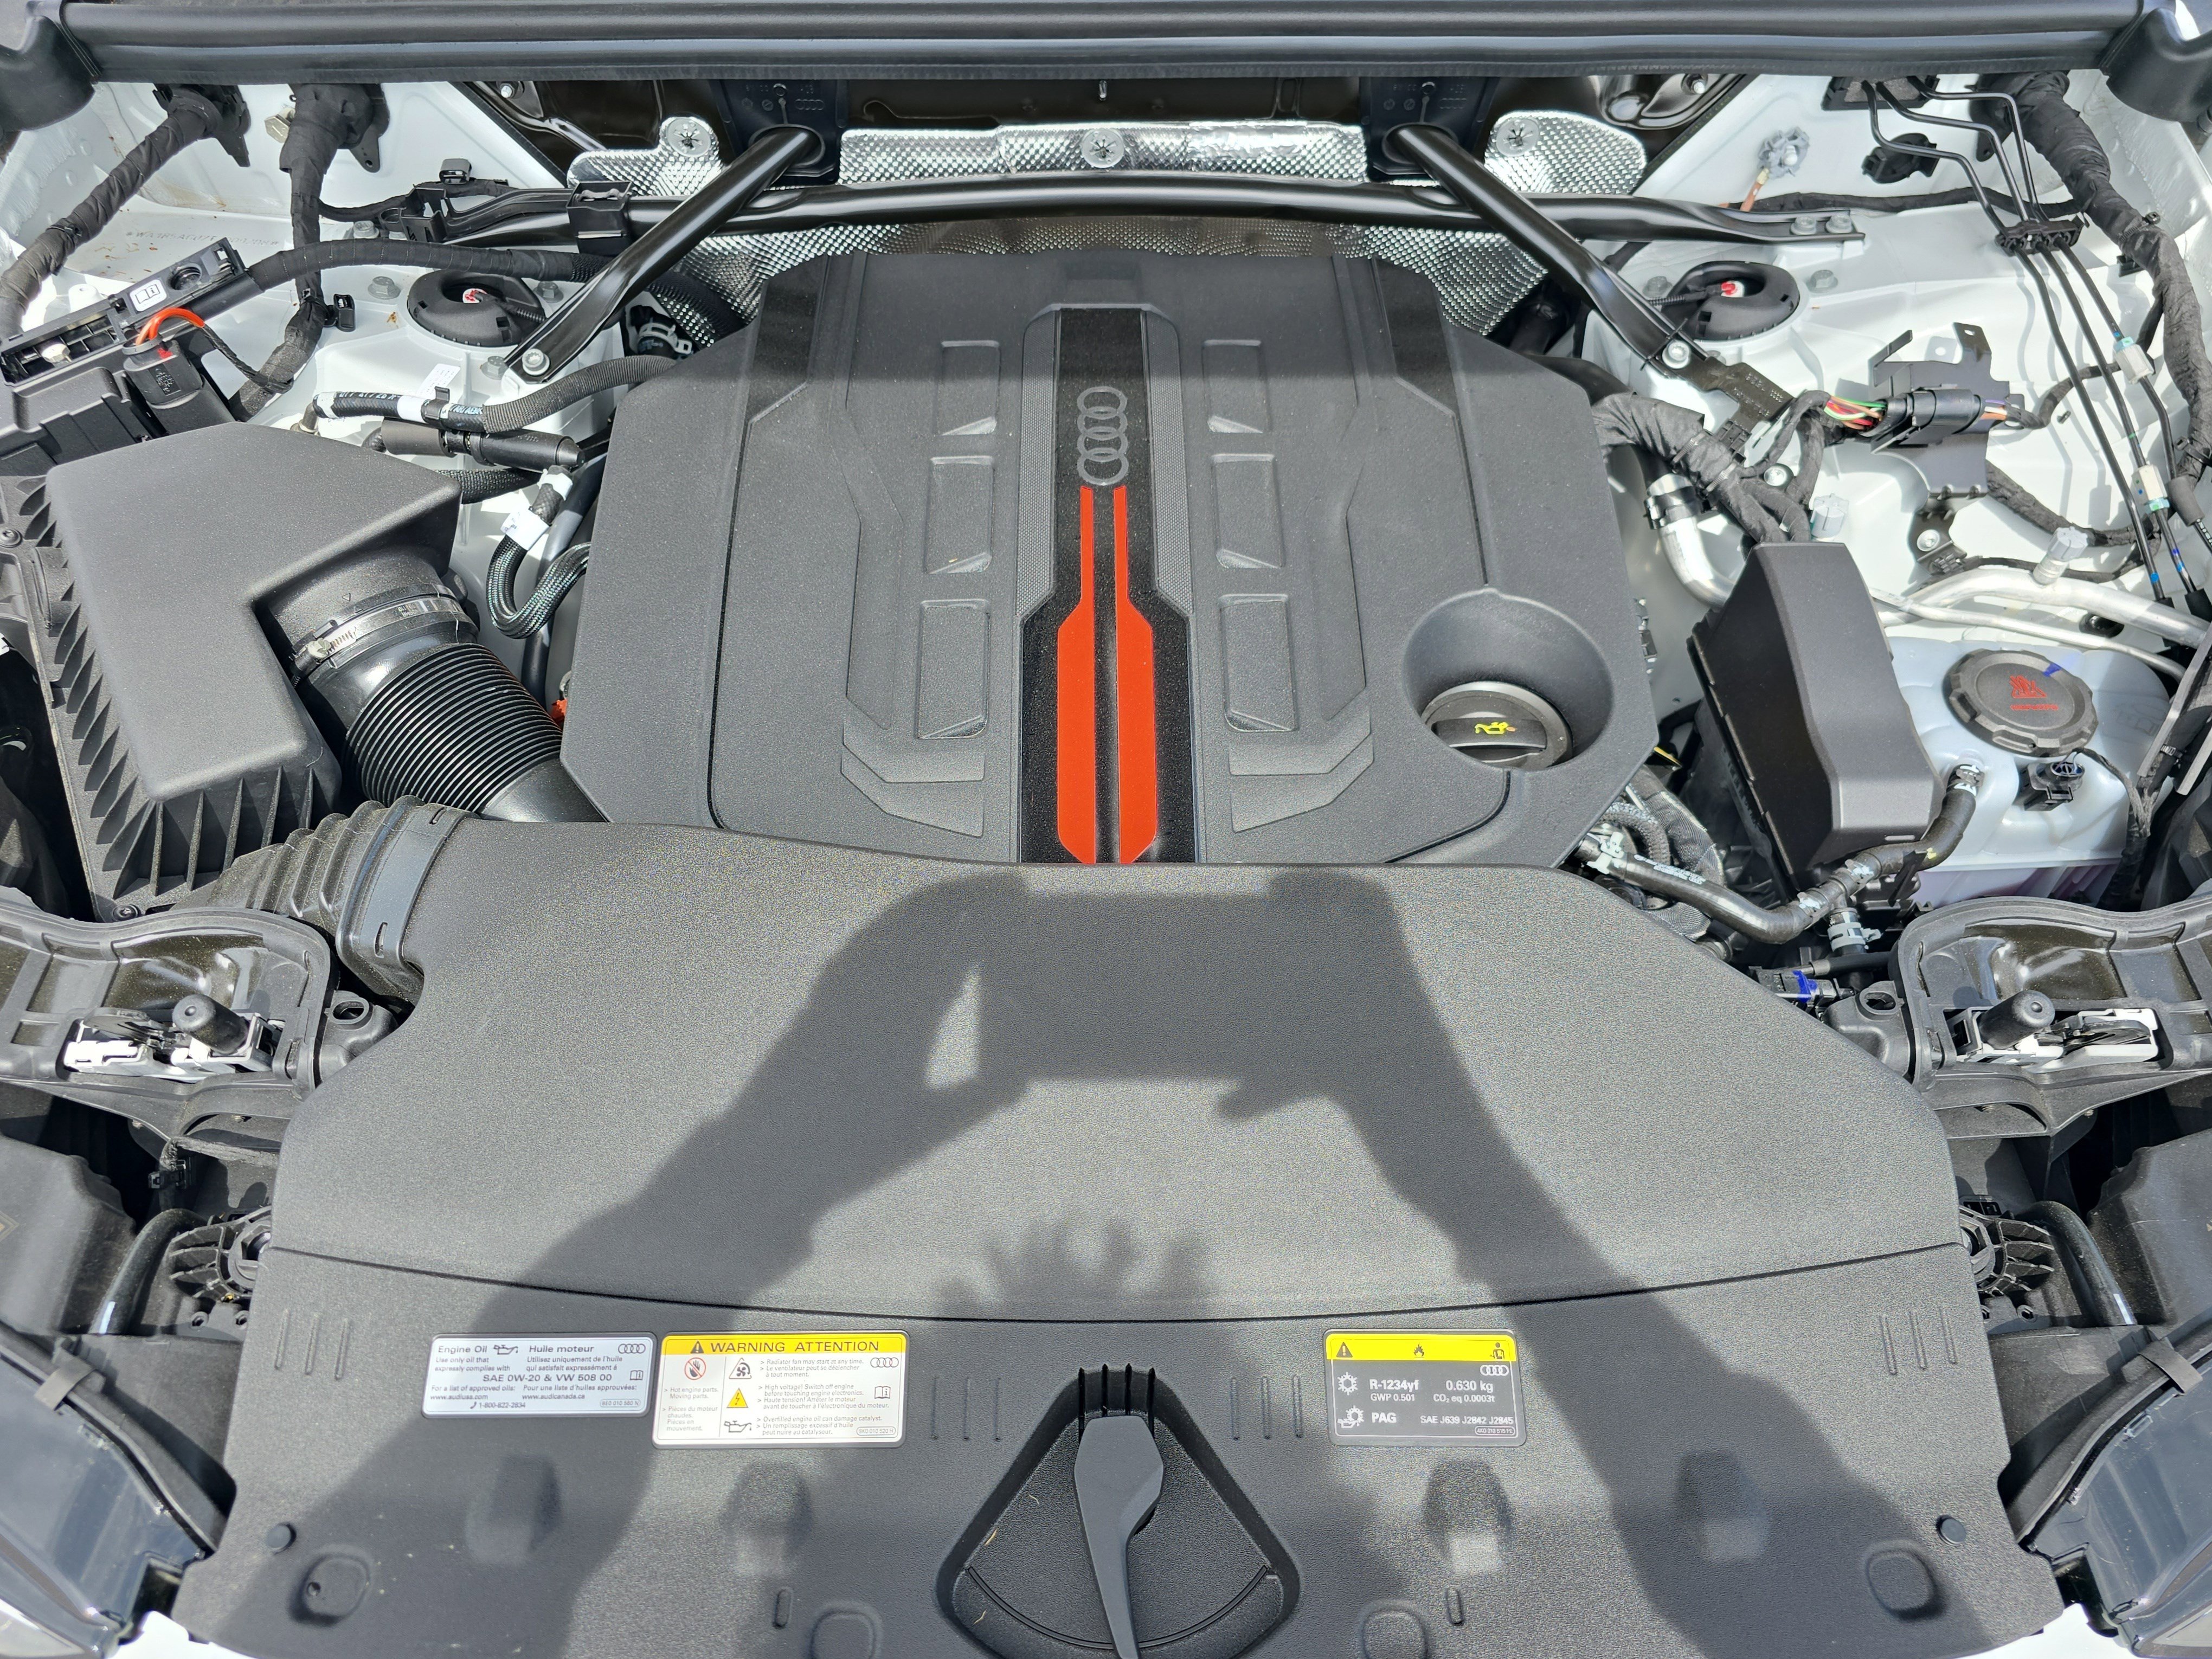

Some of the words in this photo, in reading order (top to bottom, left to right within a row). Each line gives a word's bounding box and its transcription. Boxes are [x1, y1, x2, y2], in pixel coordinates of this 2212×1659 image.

[439, 1346, 471, 1354] Engine
[711, 1342, 785, 1352] WARNING
[795, 1341, 879, 1351] ATTENTION
[1369, 1379, 1419, 1392] R-1234yf
[1446, 1381, 1476, 1391] 0.630
[1480, 1381, 1493, 1392] kg
[1372, 1413, 1397, 1423] PAG
